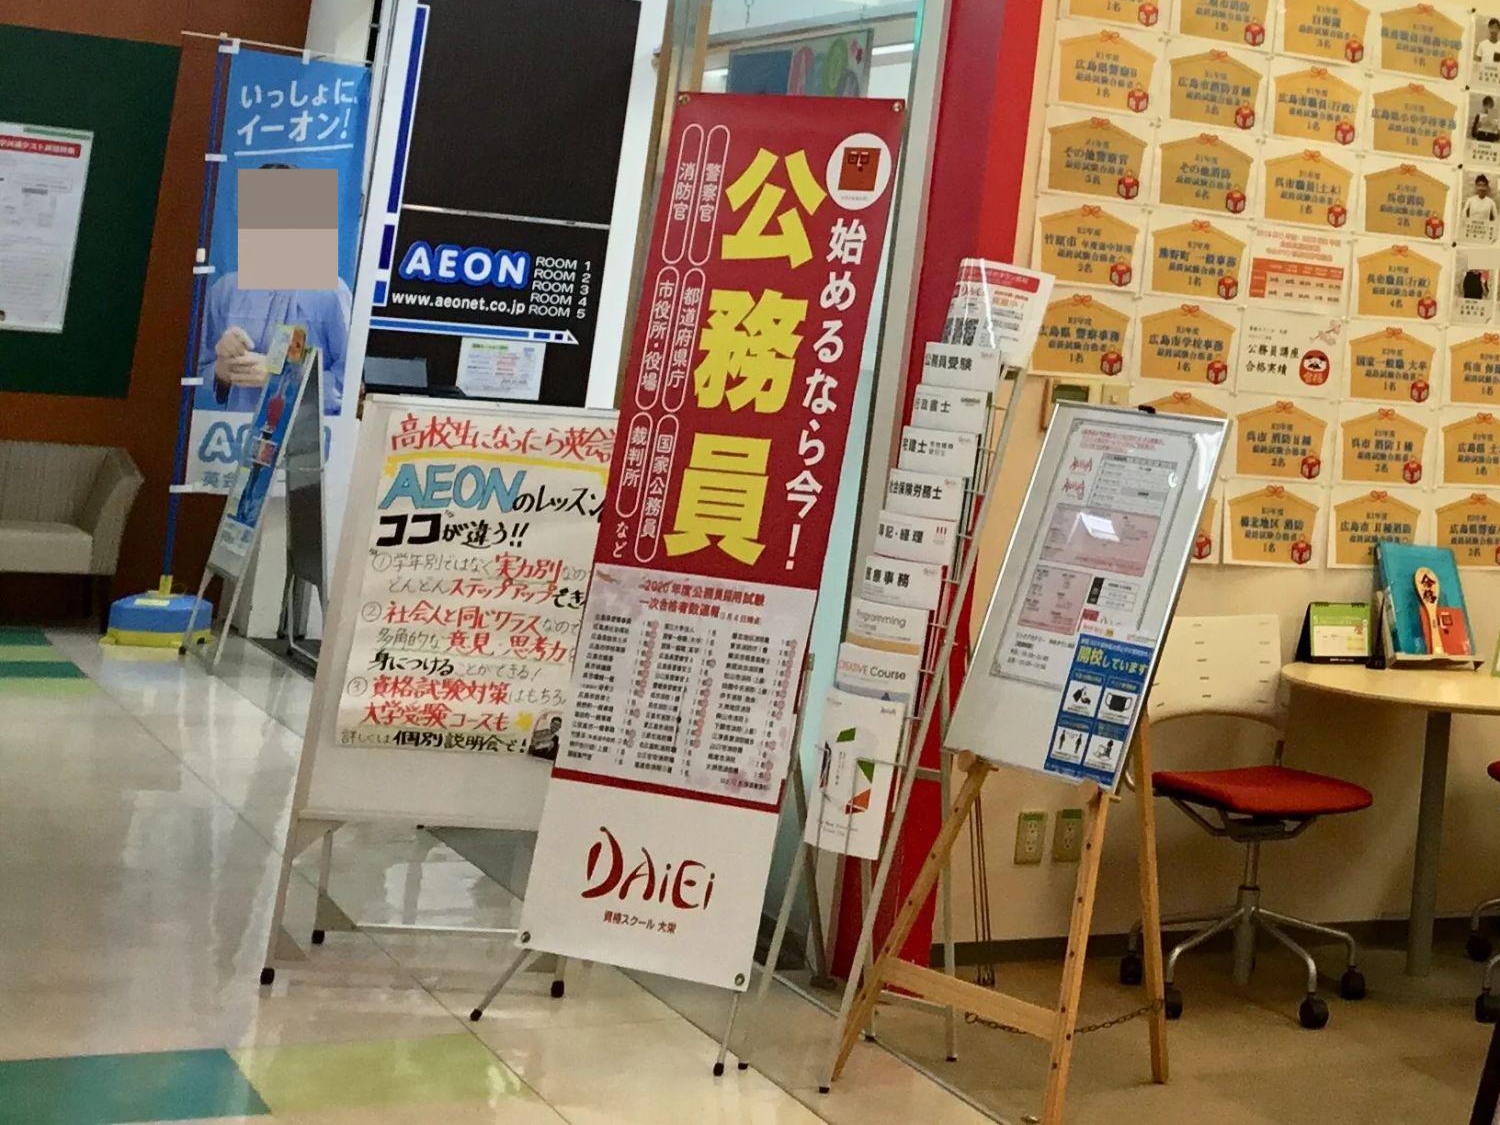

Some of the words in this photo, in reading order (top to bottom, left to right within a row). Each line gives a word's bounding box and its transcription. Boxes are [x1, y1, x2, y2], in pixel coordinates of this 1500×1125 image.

[237, 108, 351, 146] イーオン!
[673, 161, 696, 222] 消防官
[700, 161, 726, 223] 警察官
[405, 247, 526, 285] AEON
[534, 269, 575, 282] ROOM
[581, 273, 590, 283] 2
[536, 256, 577, 270] ROOM
[584, 261, 591, 271] 1
[392, 291, 526, 315] www.aeonet.co.jp
[530, 293, 572, 305] ROOM
[578, 297, 587, 306] 4
[532, 281, 573, 293] ROOM
[579, 285, 589, 295] 3
[528, 305, 570, 318] ROOM
[576, 309, 586, 319] 5
[666, 287, 701, 388] 都道府県庁
[664, 147, 827, 567] 公務員
[622, 426, 649, 487] 裁判所
[640, 433, 673, 539] 国家公務員
[612, 522, 630, 559] など
